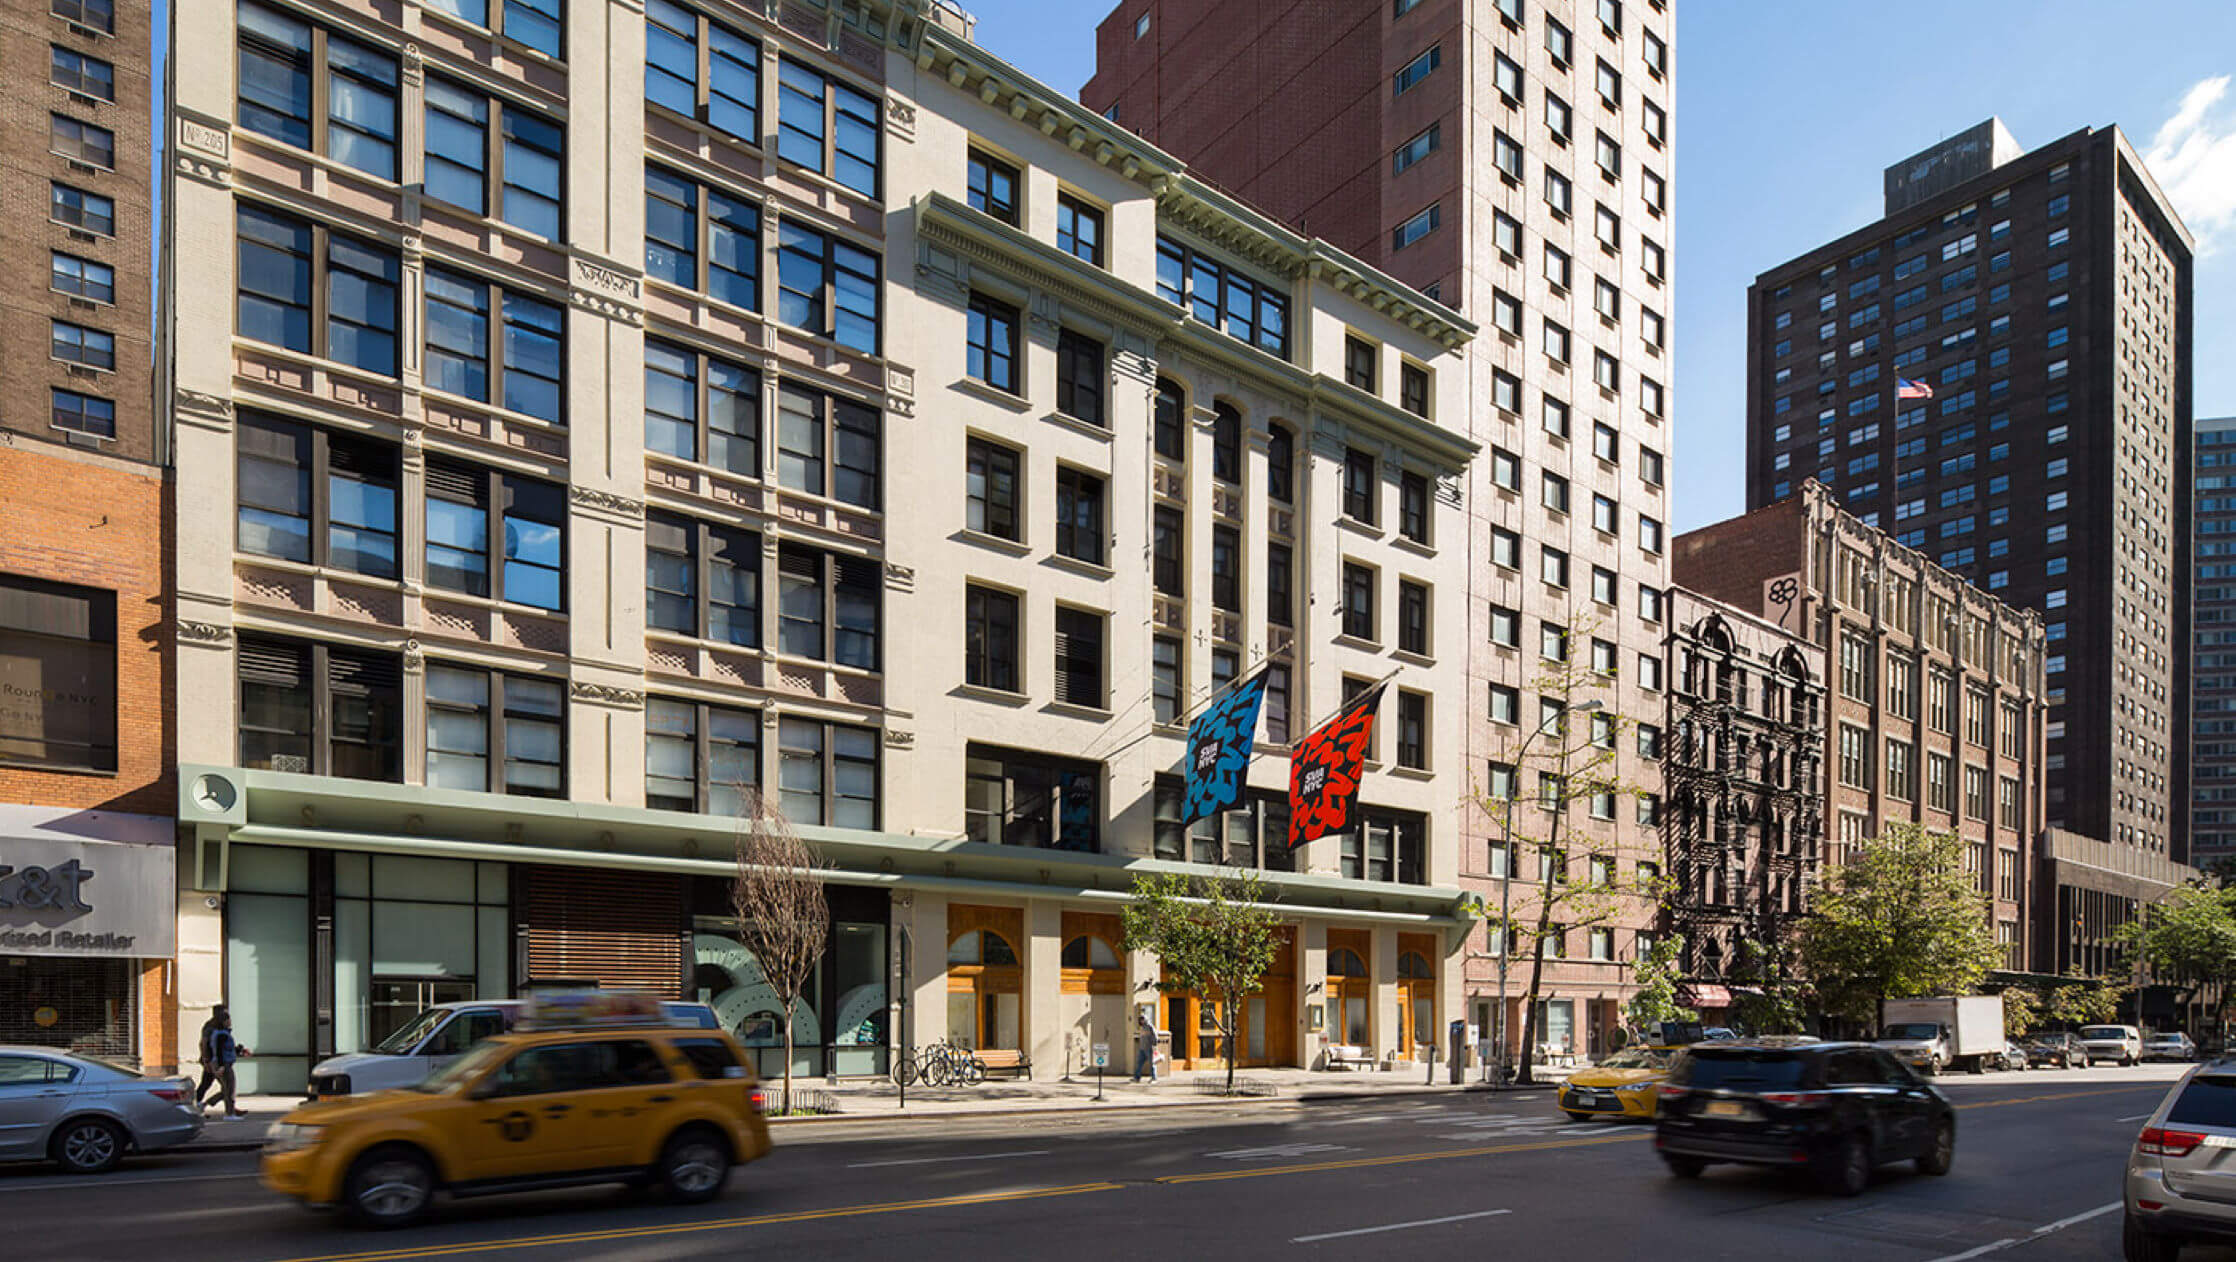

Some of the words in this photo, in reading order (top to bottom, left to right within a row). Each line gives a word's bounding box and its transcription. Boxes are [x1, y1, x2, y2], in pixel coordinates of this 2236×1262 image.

[1197, 754, 1217, 770] NYC
[1303, 777, 1323, 795] NYC
[55, 930, 136, 950] Retailer
